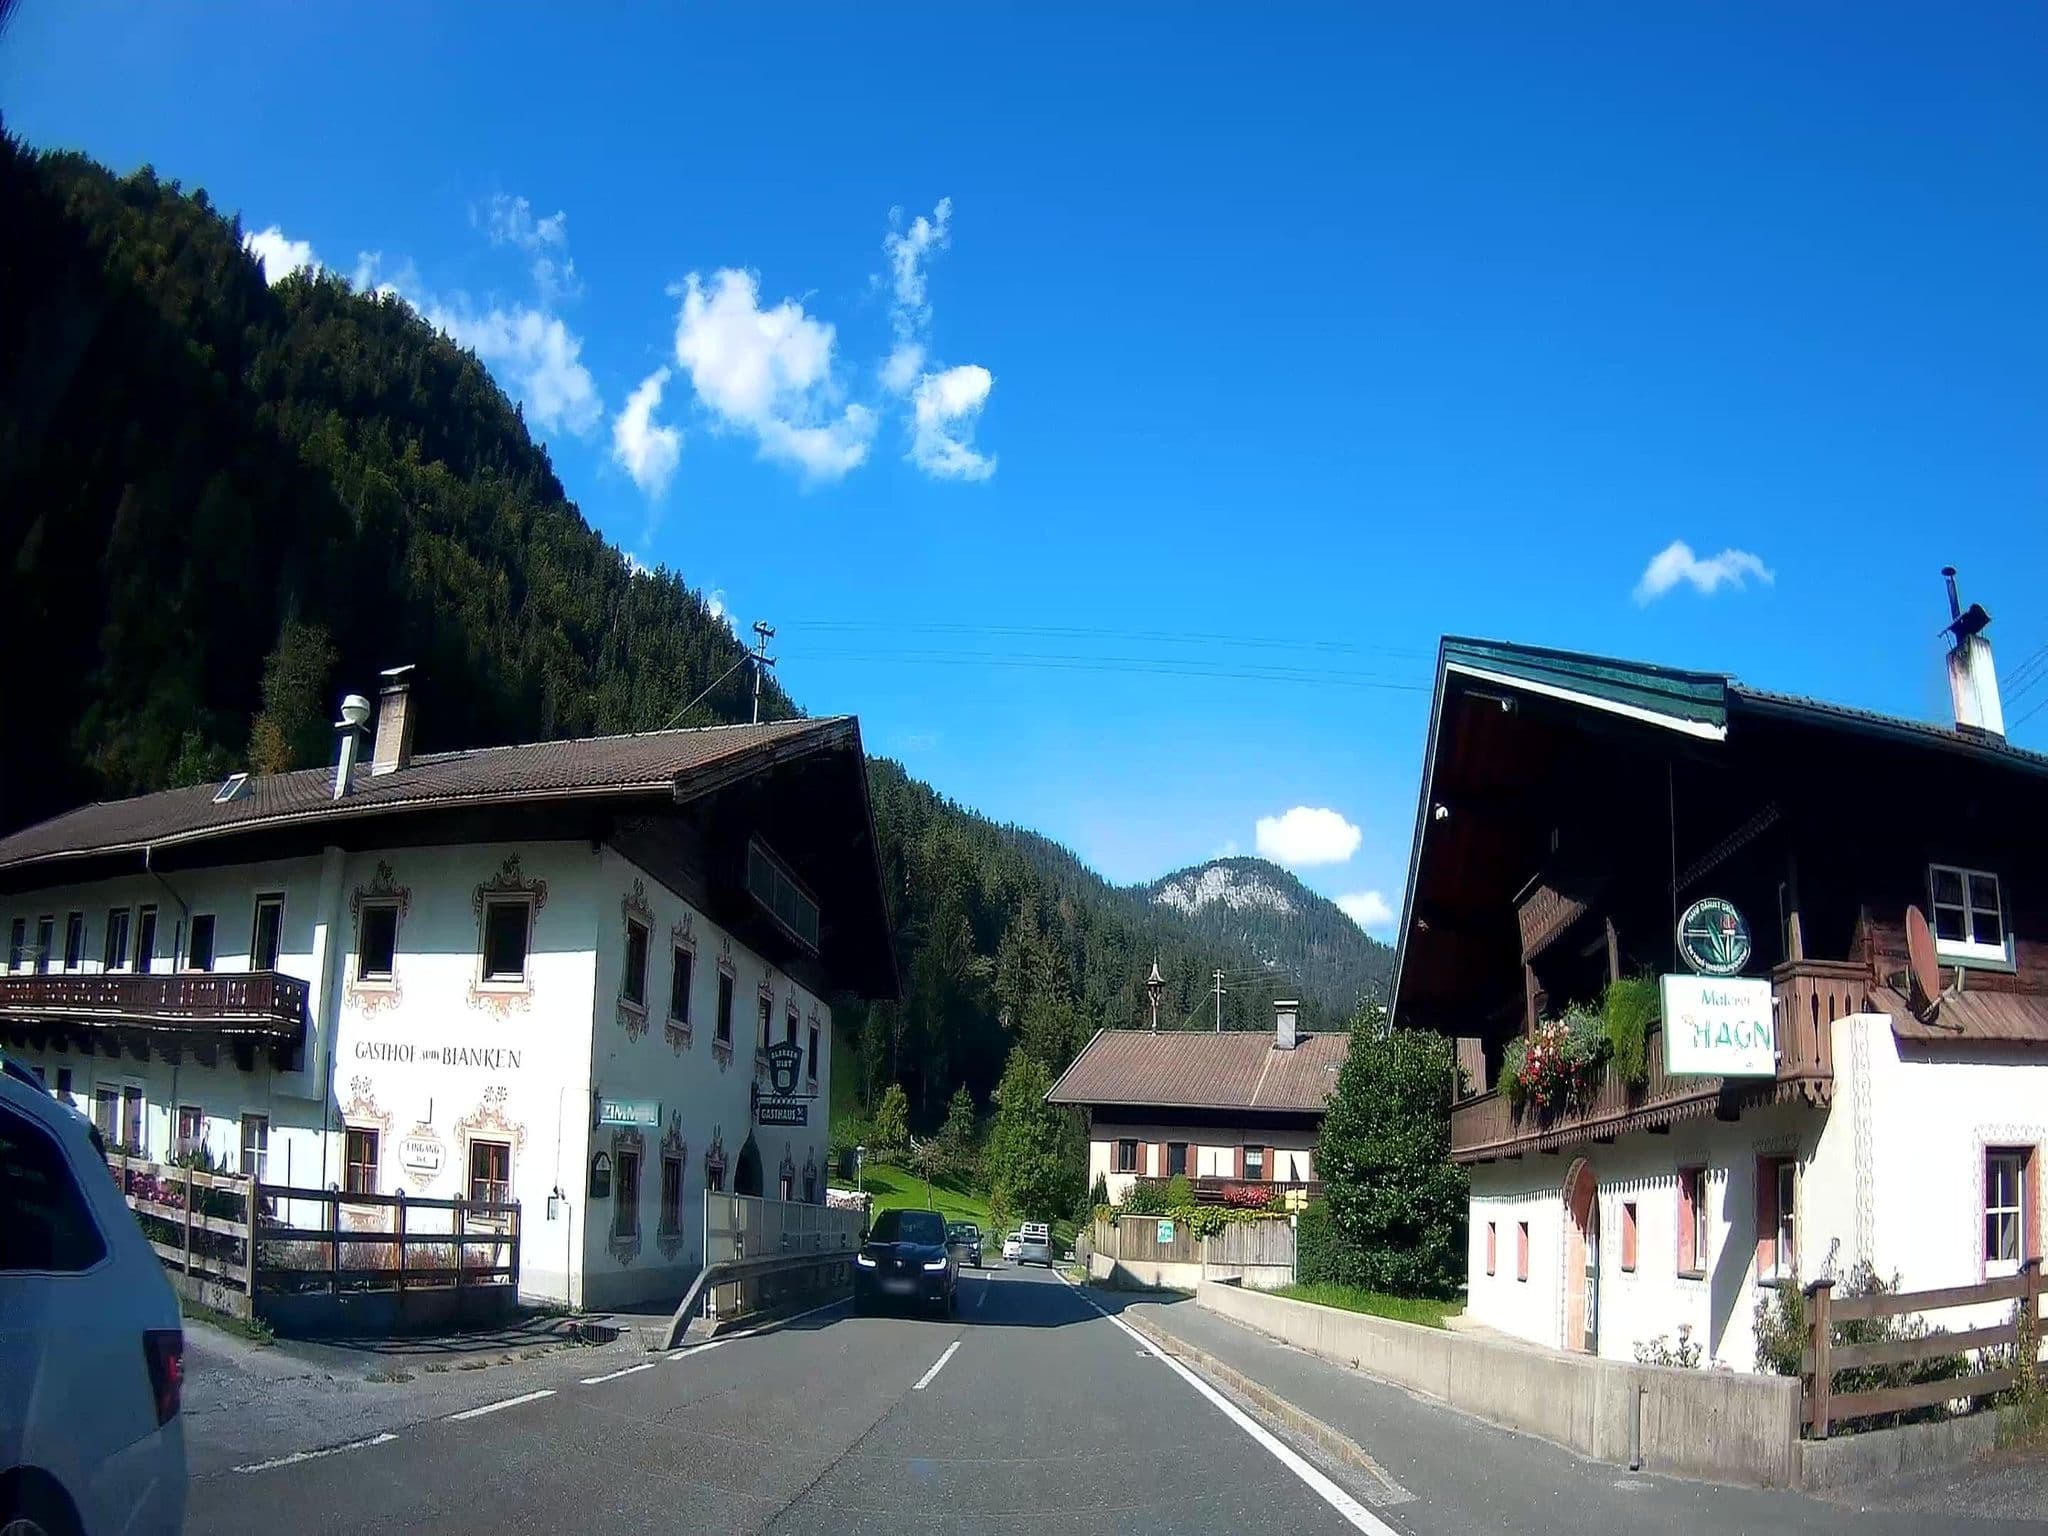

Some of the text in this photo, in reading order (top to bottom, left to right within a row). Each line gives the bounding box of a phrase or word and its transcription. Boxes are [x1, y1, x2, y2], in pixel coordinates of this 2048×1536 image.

[1693, 1019, 1771, 1051] HAGN
[355, 1041, 416, 1063] GASTHOF
[761, 1108, 796, 1120] GASTHAUS
